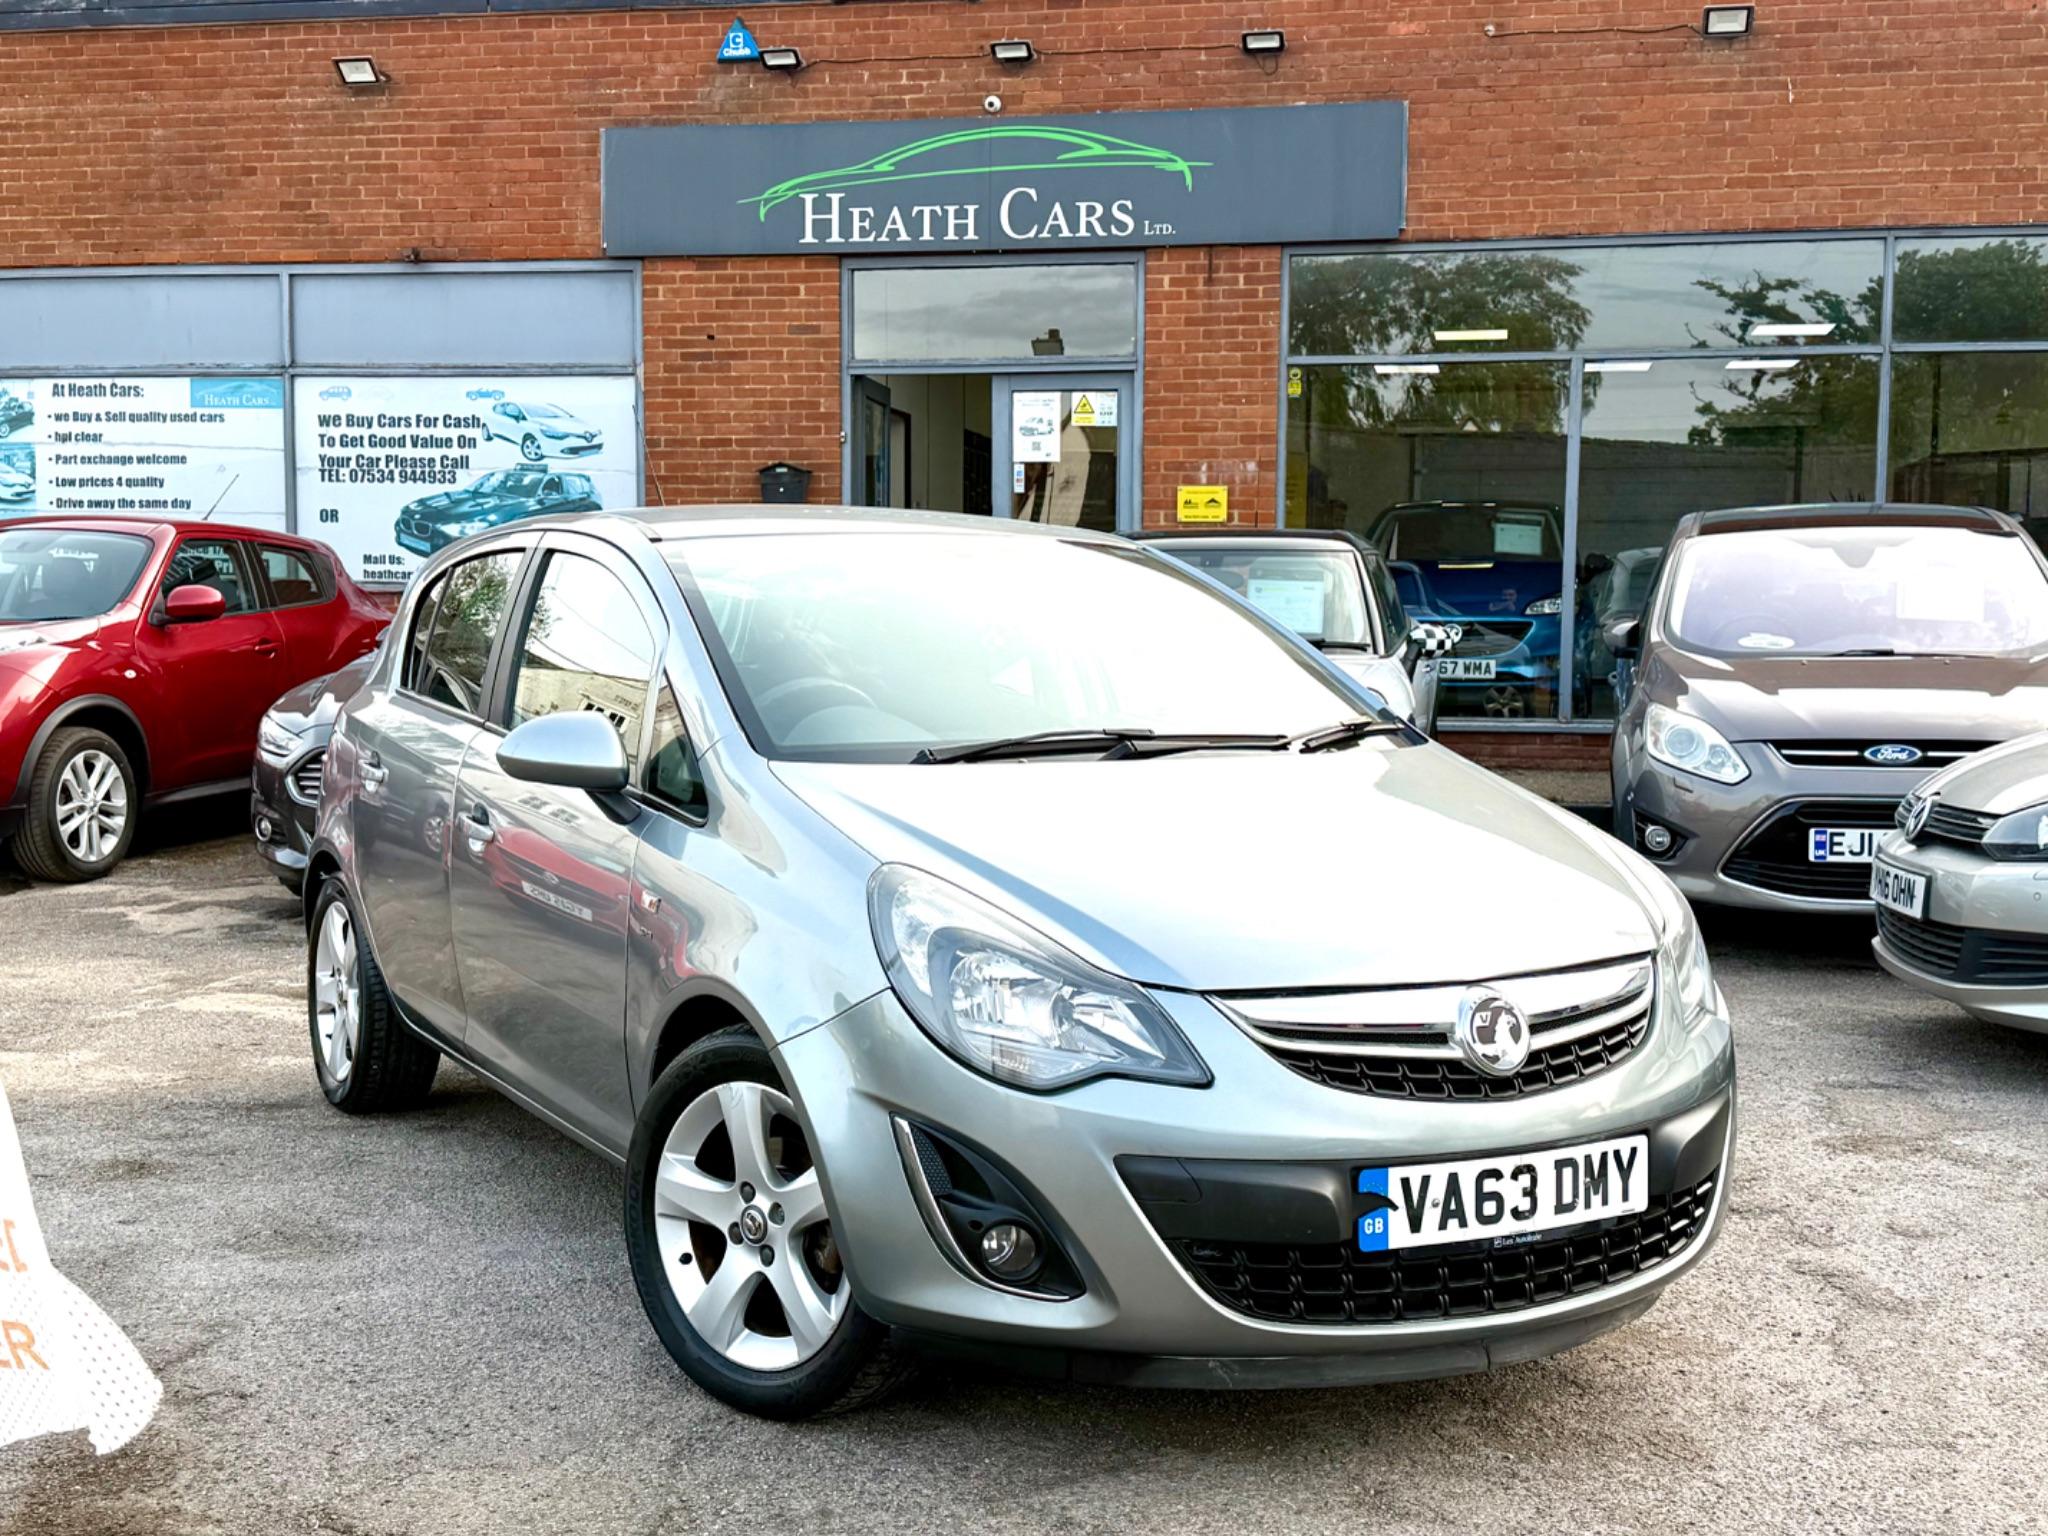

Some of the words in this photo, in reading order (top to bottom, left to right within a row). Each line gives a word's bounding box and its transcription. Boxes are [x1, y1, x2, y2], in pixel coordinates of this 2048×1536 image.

[798, 192, 980, 244] HEATH
[1000, 187, 1135, 240] CARS
[52, 383, 65, 397] At
[68, 383, 107, 397] Heath
[110, 382, 145, 398] Cars:
[72, 411, 93, 423] Buy
[95, 411, 102, 422] &
[105, 411, 126, 422] Sell
[128, 411, 168, 424] quality
[170, 411, 197, 423] used
[200, 413, 225, 423] cars
[346, 413, 374, 430] Buy
[377, 413, 412, 429] Cars
[415, 413, 439, 428] For
[442, 413, 482, 429] Cash
[74, 431, 103, 442] clear
[318, 433, 336, 448] To
[339, 433, 365, 448] Get
[368, 434, 407, 449] Good
[409, 434, 453, 449] Value
[457, 434, 477, 449] On
[55, 454, 78, 465] Part
[80, 454, 134, 466] exchange
[136, 454, 187, 465] welcome
[318, 454, 352, 469] Your
[355, 454, 381, 469] Car
[385, 454, 436, 469] Please
[439, 454, 470, 470] Call
[55, 477, 77, 487] Low
[78, 477, 114, 489] prices
[116, 476, 123, 488] 4
[125, 476, 165, 488] quality
[318, 468, 346, 483] TEL:
[349, 468, 395, 484] 07534
[399, 469, 457, 484] 944933
[56, 498, 84, 509] Drive
[87, 499, 115, 510] away
[117, 498, 137, 509] the
[138, 499, 169, 509] same
[171, 498, 191, 510] day
[319, 508, 339, 523] OR
[363, 554, 386, 565] Mail
[388, 554, 405, 566] Us:
[363, 568, 414, 580] heathcar
[1438, 660, 1458, 675] 67
[1463, 661, 1492, 676] WMA
[1400, 1163, 1538, 1234] VA63
[1553, 1146, 1638, 1215] DMY
[1364, 1217, 1384, 1235] GB
